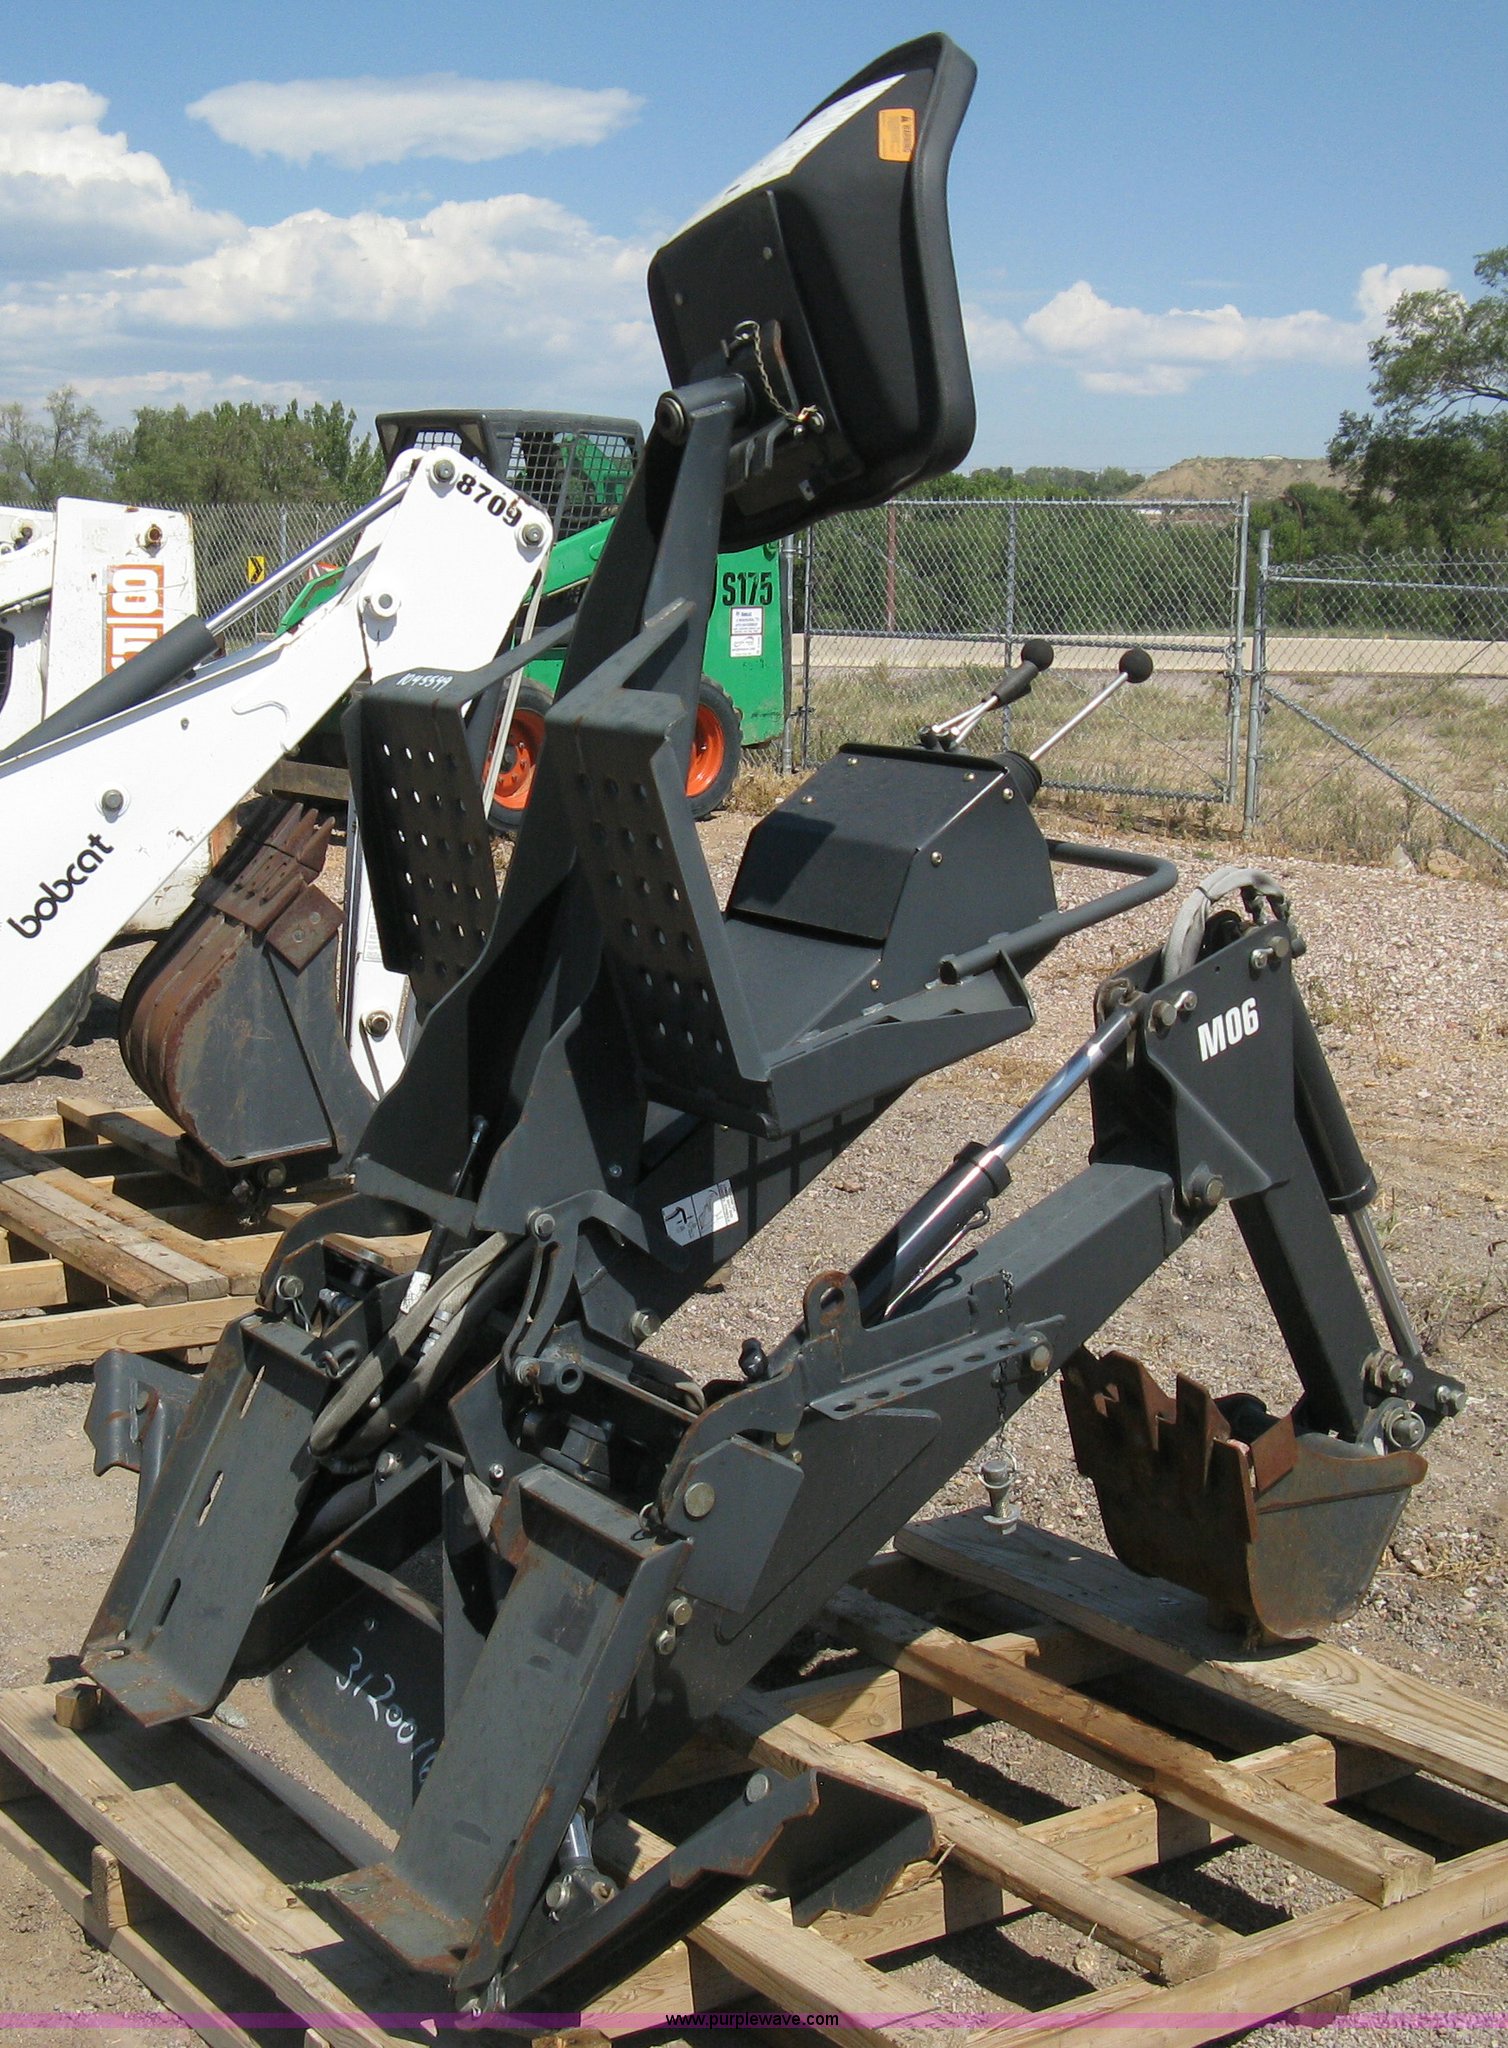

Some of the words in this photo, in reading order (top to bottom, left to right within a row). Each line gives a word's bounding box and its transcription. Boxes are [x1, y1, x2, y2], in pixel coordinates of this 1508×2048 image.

[456, 473, 522, 527] 8709
[722, 571, 773, 607] S175
[6, 833, 115, 939] bobcat
[1197, 997, 1260, 1062] M06
